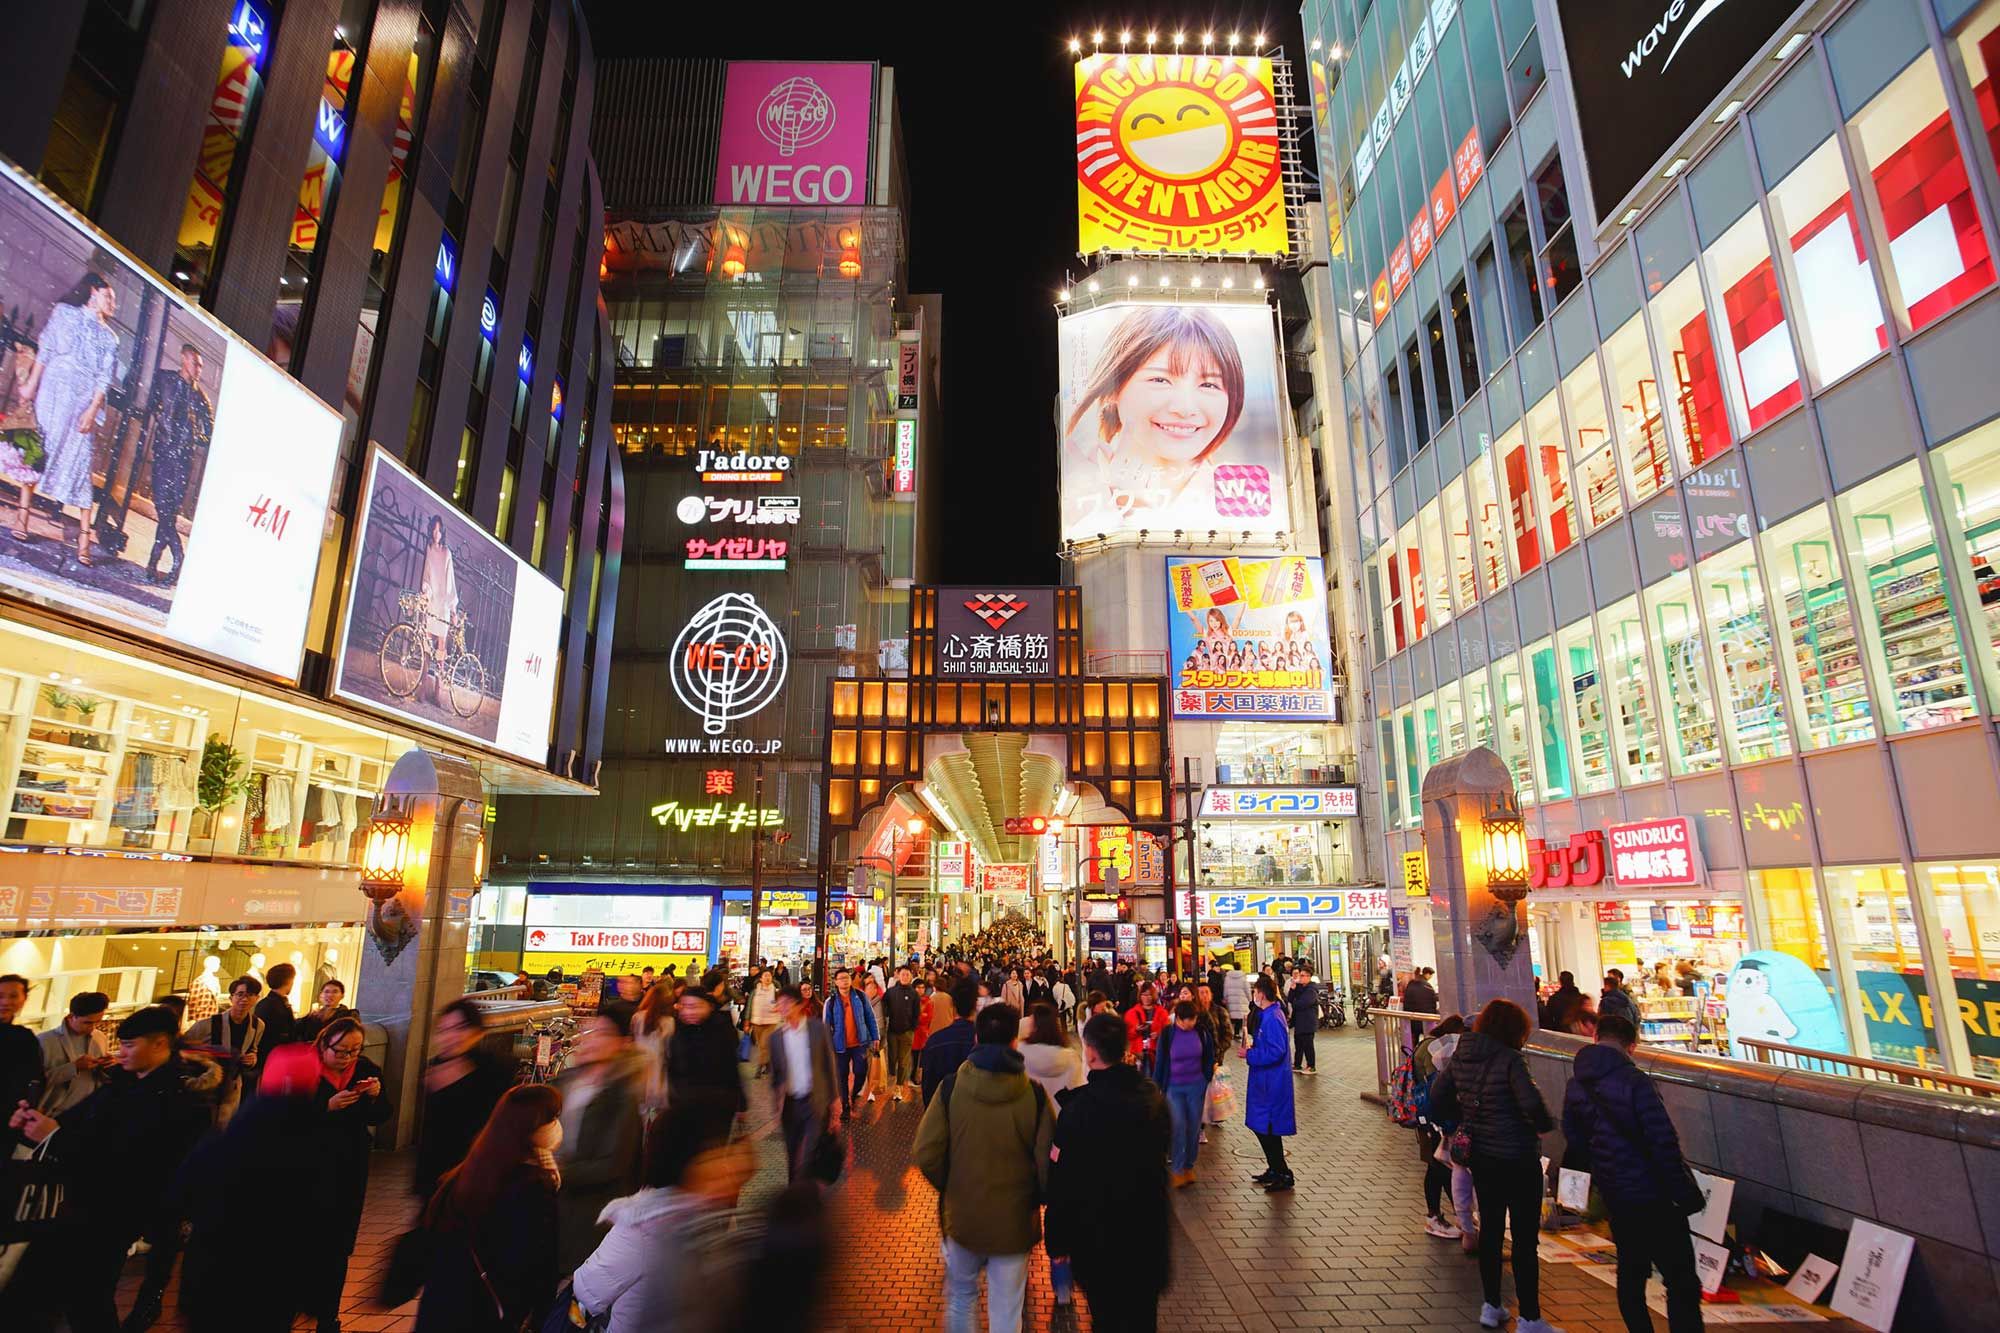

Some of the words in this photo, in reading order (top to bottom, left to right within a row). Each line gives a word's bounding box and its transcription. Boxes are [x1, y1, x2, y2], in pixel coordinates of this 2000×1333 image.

[1078, 55, 1249, 124] NICONICO
[731, 164, 853, 203] WEGO
[1099, 139, 1278, 219] RENTACAR
[1084, 201, 1279, 248] ニコニコレンタカー
[903, 352, 917, 386] プリ機
[902, 395, 914, 405] 7F
[695, 450, 791, 472] J'adore
[710, 473, 739, 481] DINING
[246, 494, 291, 541] H&M
[686, 537, 787, 560] サイゼリヤ
[942, 633, 1049, 659] 心斎橋筋
[943, 661, 966, 673] SHIN
[970, 661, 986, 673] SAI
[1179, 693, 1202, 712] 薬
[1210, 694, 1324, 712] 大国薬粧店
[664, 738, 783, 754] WWW.WEGO.JP
[705, 770, 734, 795] 薬
[1211, 790, 1231, 812] 薬
[1237, 793, 1321, 811] ダイコク
[1324, 791, 1354, 807] 免税
[651, 801, 785, 832] マツモトキヨシ
[1613, 825, 1685, 849] SUNDRUG
[1214, 895, 1340, 915] ダイコク
[570, 931, 593, 947] Tax
[599, 931, 629, 947] Free
[632, 931, 669, 949] Shop
[673, 931, 705, 950] 免税
[16, 1183, 64, 1222] GAP
